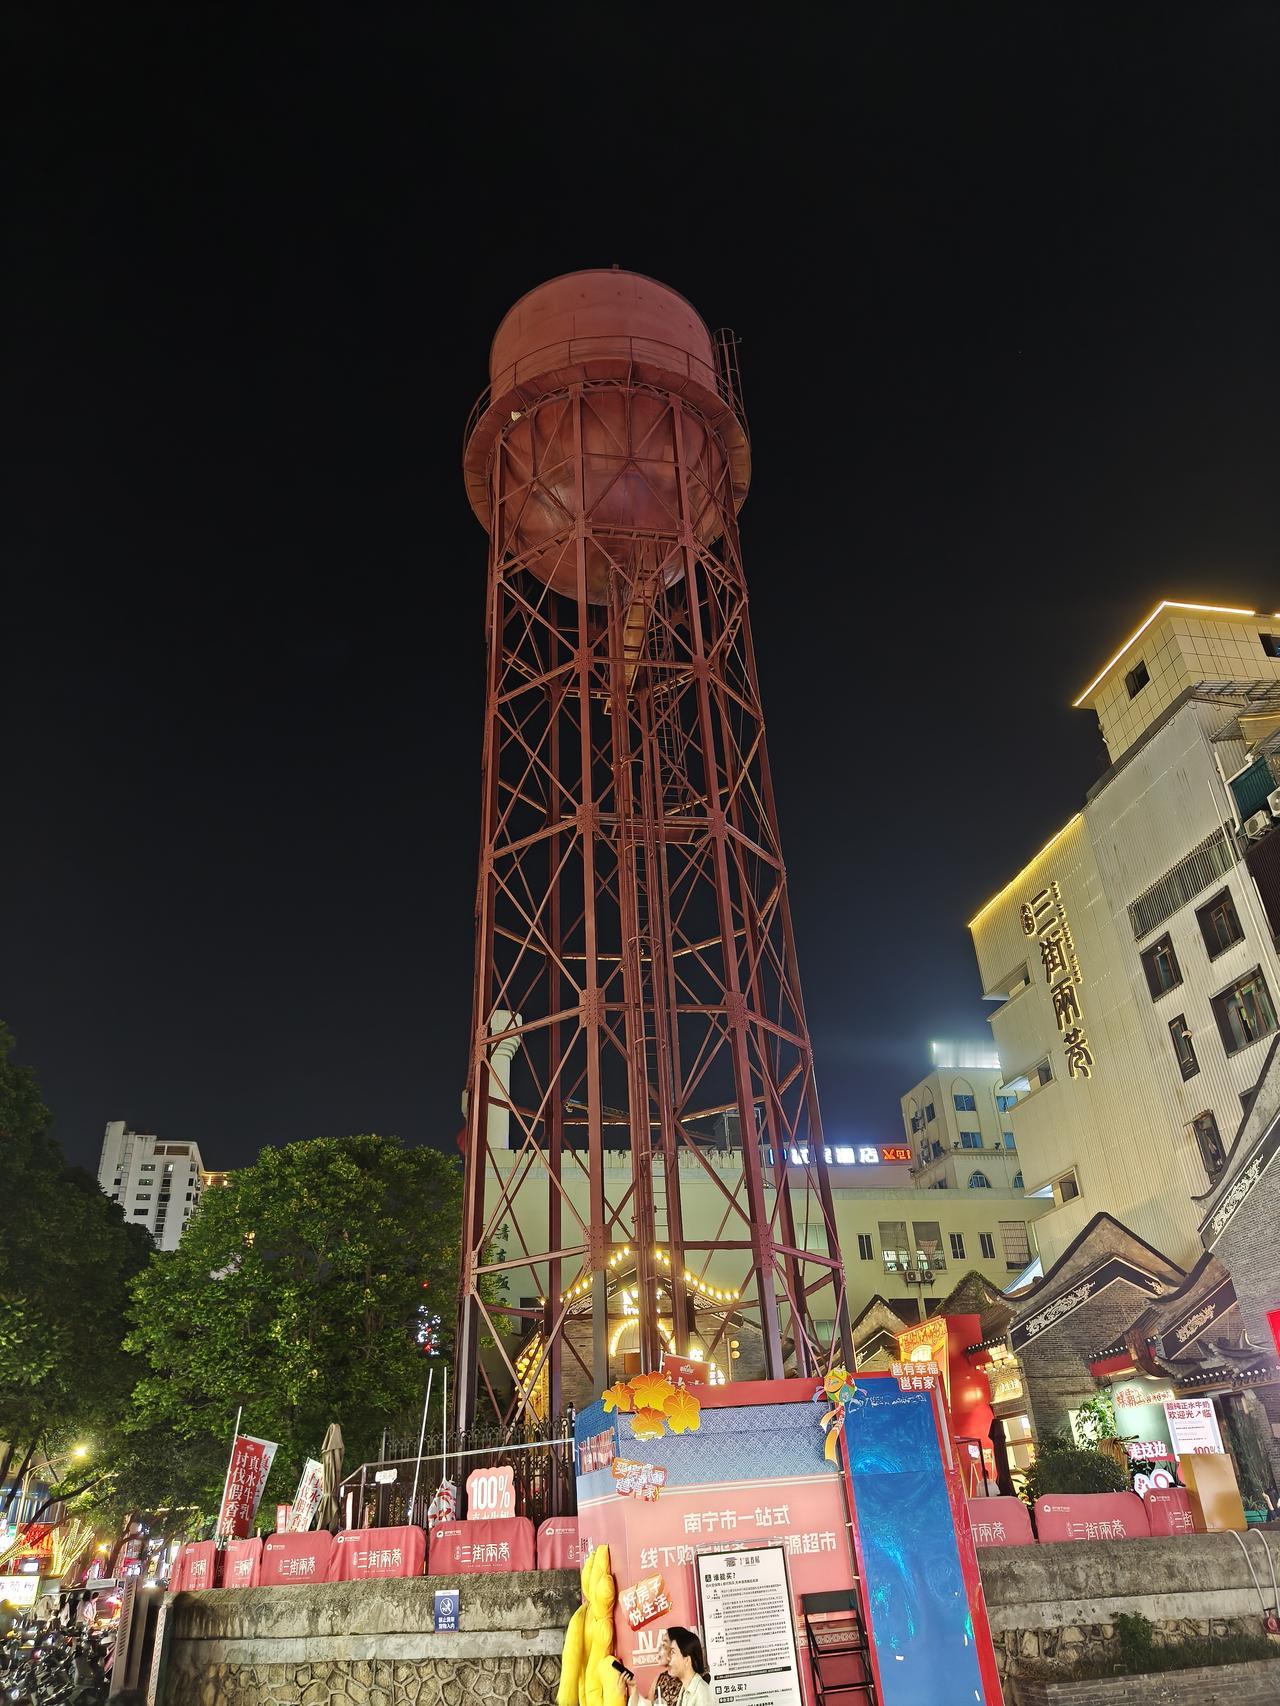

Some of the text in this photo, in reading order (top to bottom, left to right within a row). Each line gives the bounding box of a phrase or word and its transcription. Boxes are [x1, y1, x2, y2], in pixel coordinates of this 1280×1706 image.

[891, 1361, 939, 1376] 邕有幸福
[900, 1375, 935, 1390] 邕有家
[221, 1450, 248, 1536] 讨伐假香浓
[239, 1455, 260, 1521] 真水牛乳
[471, 1474, 510, 1510] 100%
[683, 1504, 791, 1534] 南宁市一站式
[622, 1578, 662, 1611] 好房子
[629, 1594, 669, 1627] 悦生活
